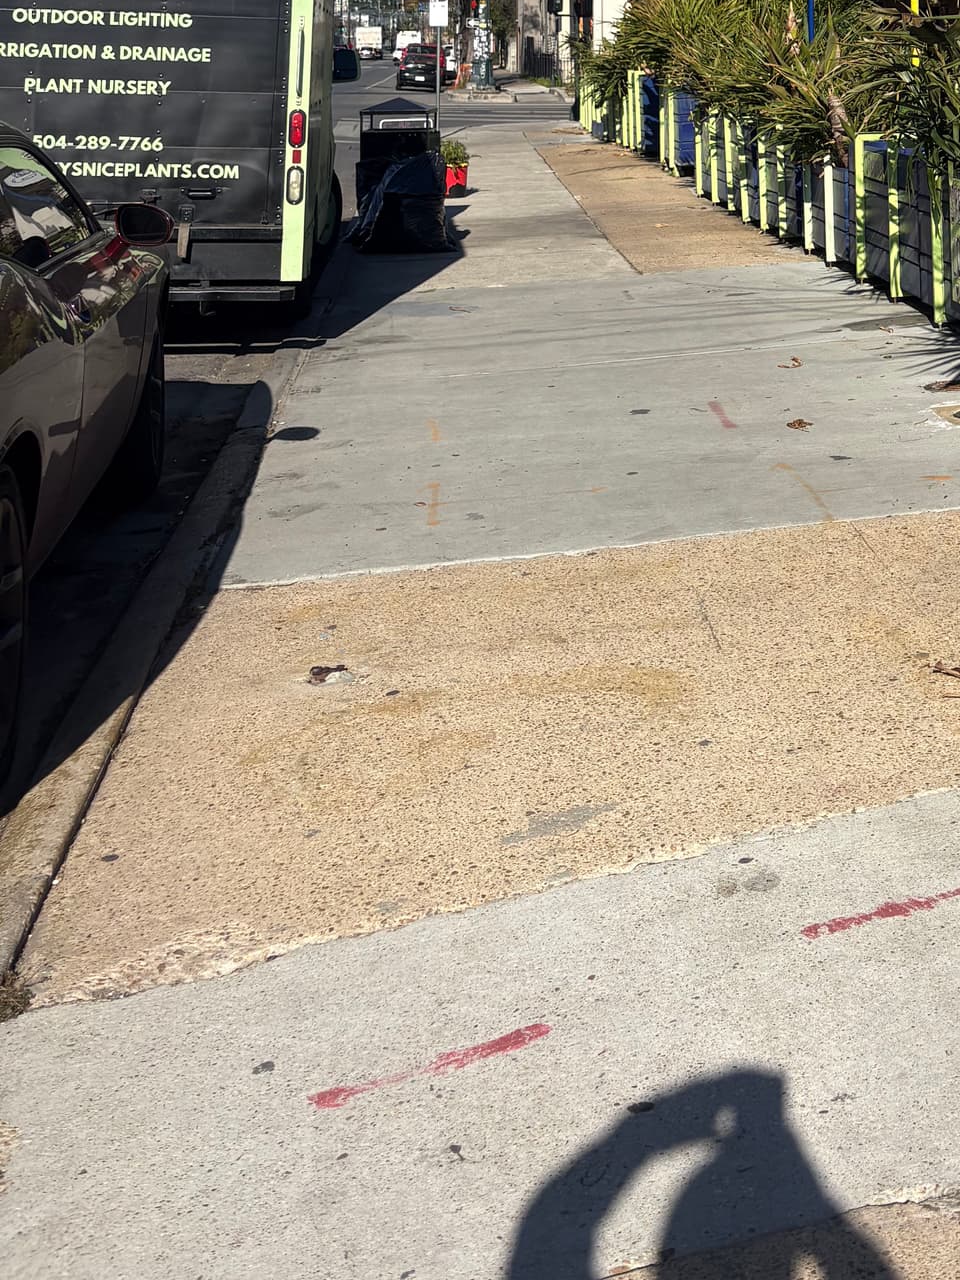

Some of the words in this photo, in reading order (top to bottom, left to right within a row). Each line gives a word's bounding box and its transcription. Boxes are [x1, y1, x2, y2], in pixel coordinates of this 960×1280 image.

[12, 8, 105, 25] OUTDOOR
[109, 11, 193, 29] LIGHTING
[0, 42, 97, 60] RRIGATION
[100, 45, 116, 61] &
[119, 46, 212, 63] DRAINAGE
[24, 77, 84, 95] PLANT
[87, 79, 172, 96] NURSERY
[32, 134, 164, 152] 504-289-7766
[54, 161, 240, 180] YSNICEPLANTS.COM
